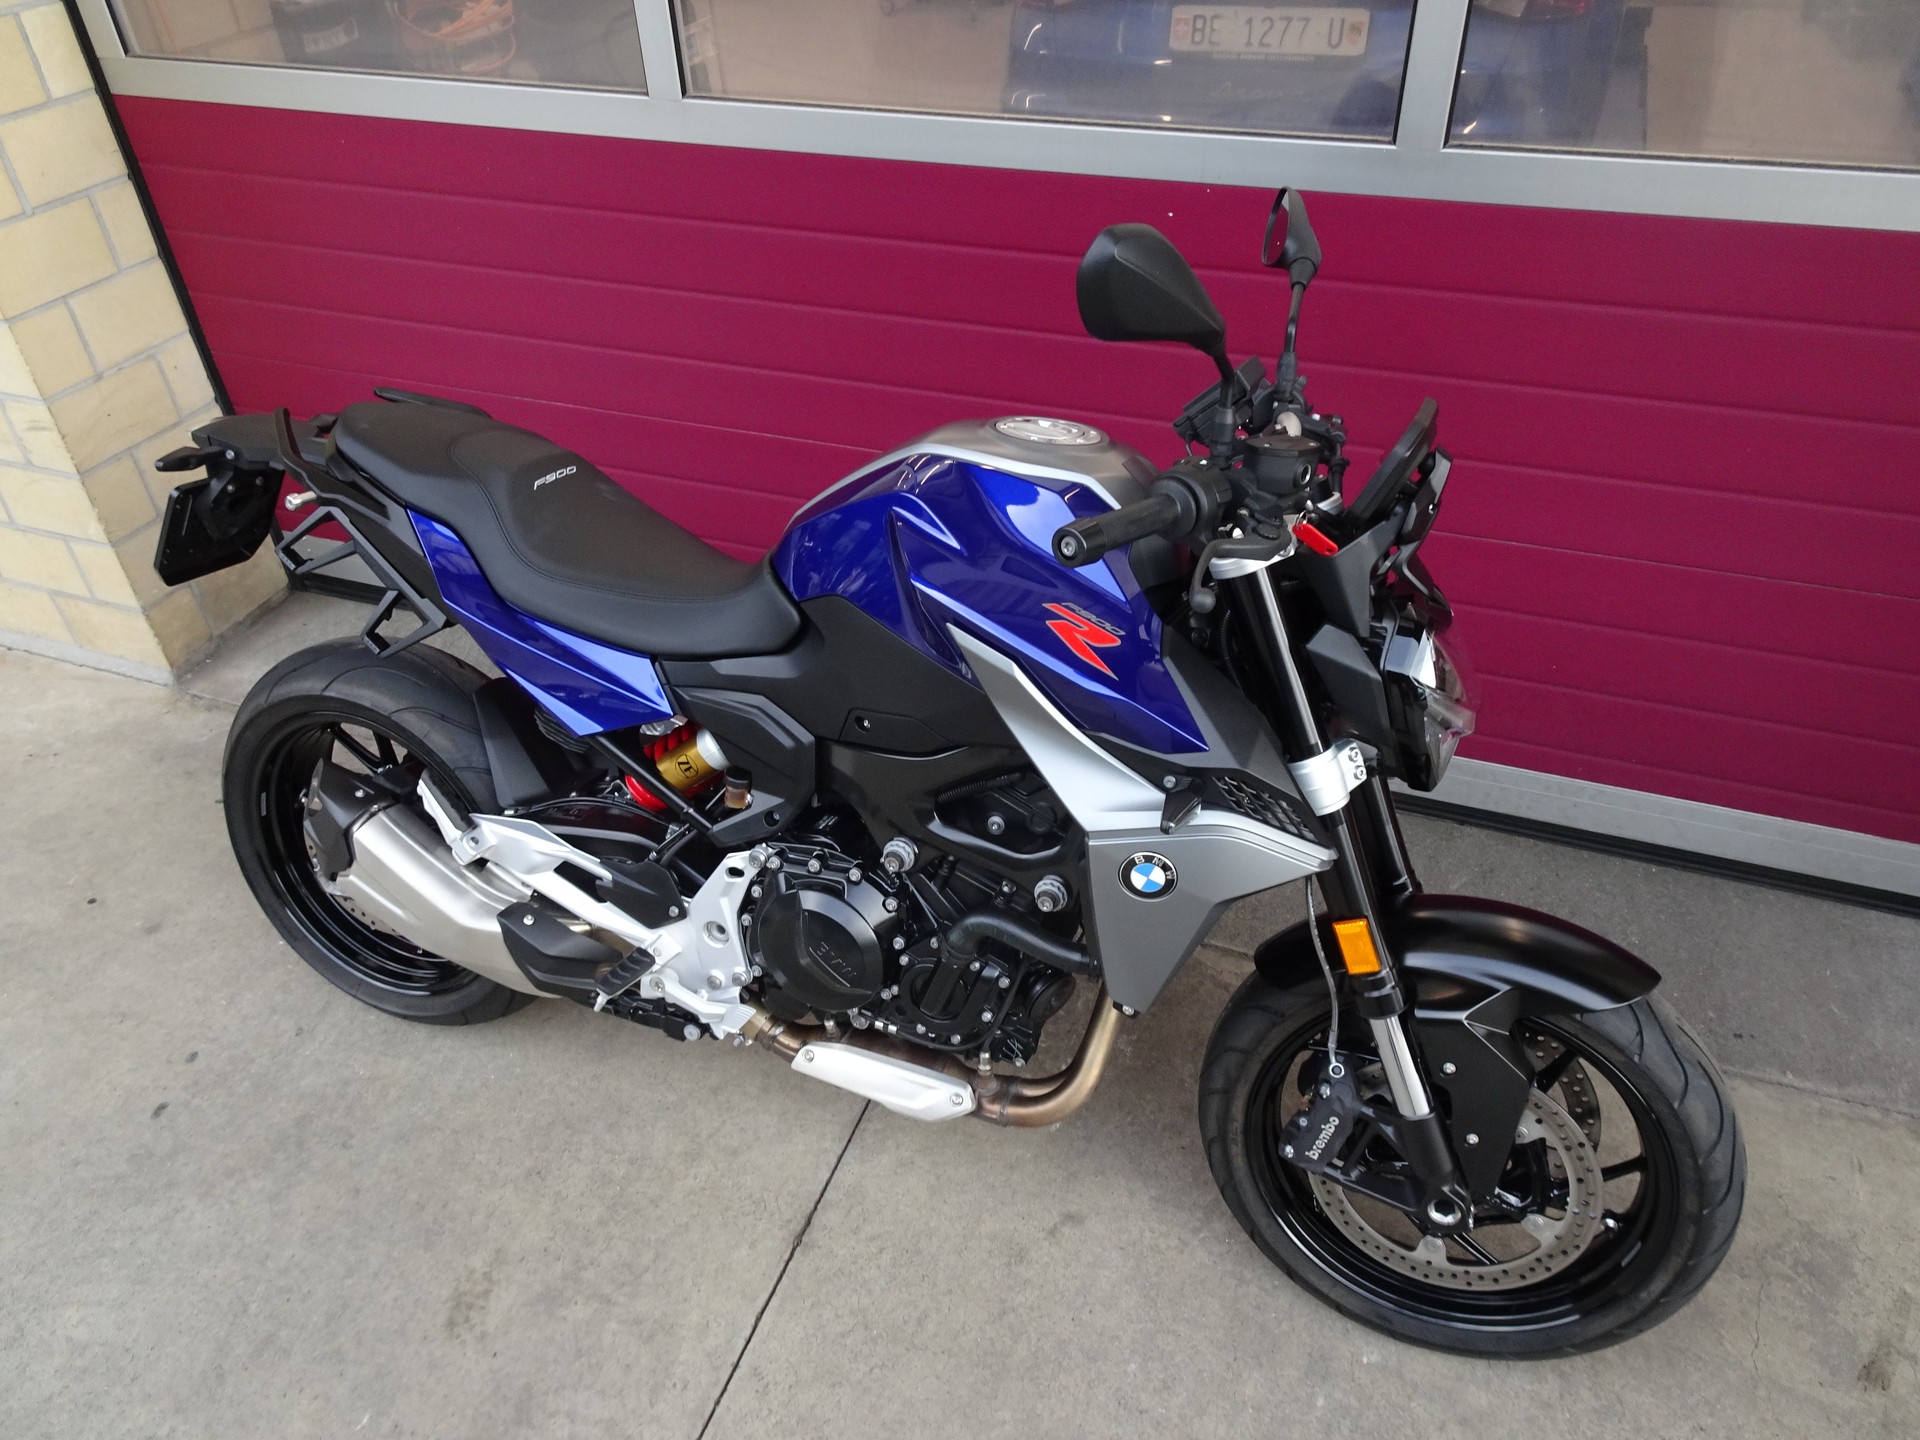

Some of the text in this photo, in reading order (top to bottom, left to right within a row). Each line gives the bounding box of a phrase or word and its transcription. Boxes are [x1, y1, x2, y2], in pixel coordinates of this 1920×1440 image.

[1191, 14, 1346, 49] BE 1277 U
[533, 465, 577, 491] F900
[1061, 602, 1126, 636] F900
[1041, 602, 1122, 681] R
[1134, 855, 1176, 880] BMW
[1304, 1116, 1340, 1161] brembo
